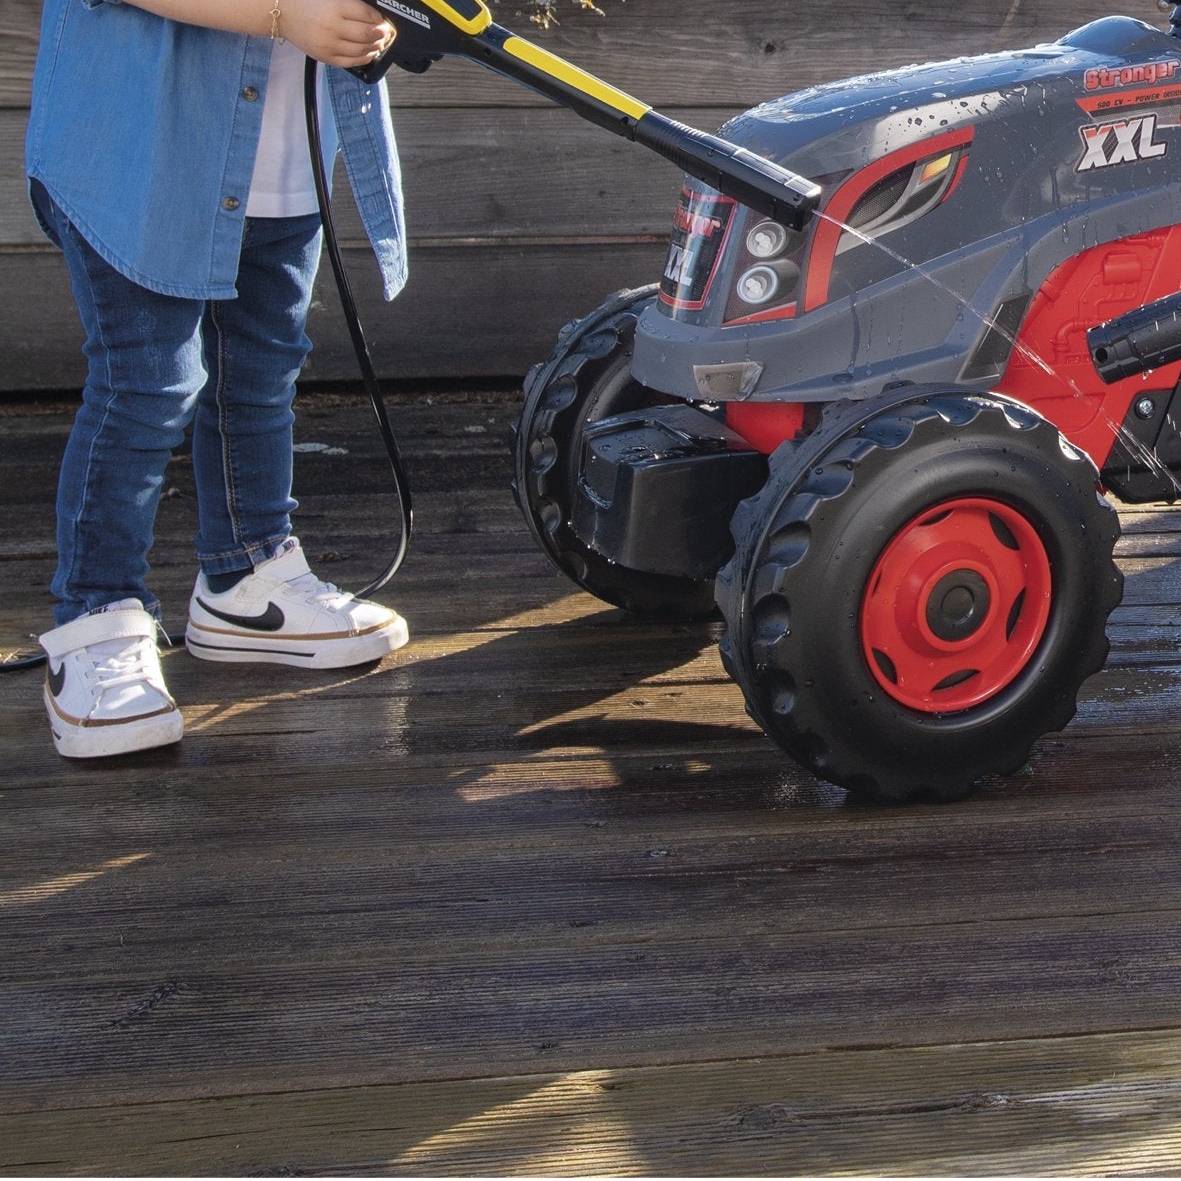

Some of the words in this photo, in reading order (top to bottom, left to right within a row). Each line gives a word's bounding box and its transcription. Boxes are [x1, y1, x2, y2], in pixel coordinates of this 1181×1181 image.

[1085, 60, 1181, 90] Stronger
[1097, 100, 1111, 109] 500
[1135, 93, 1160, 103] POWER
[1076, 115, 1167, 173] XXL
[664, 243, 694, 286] XXL
